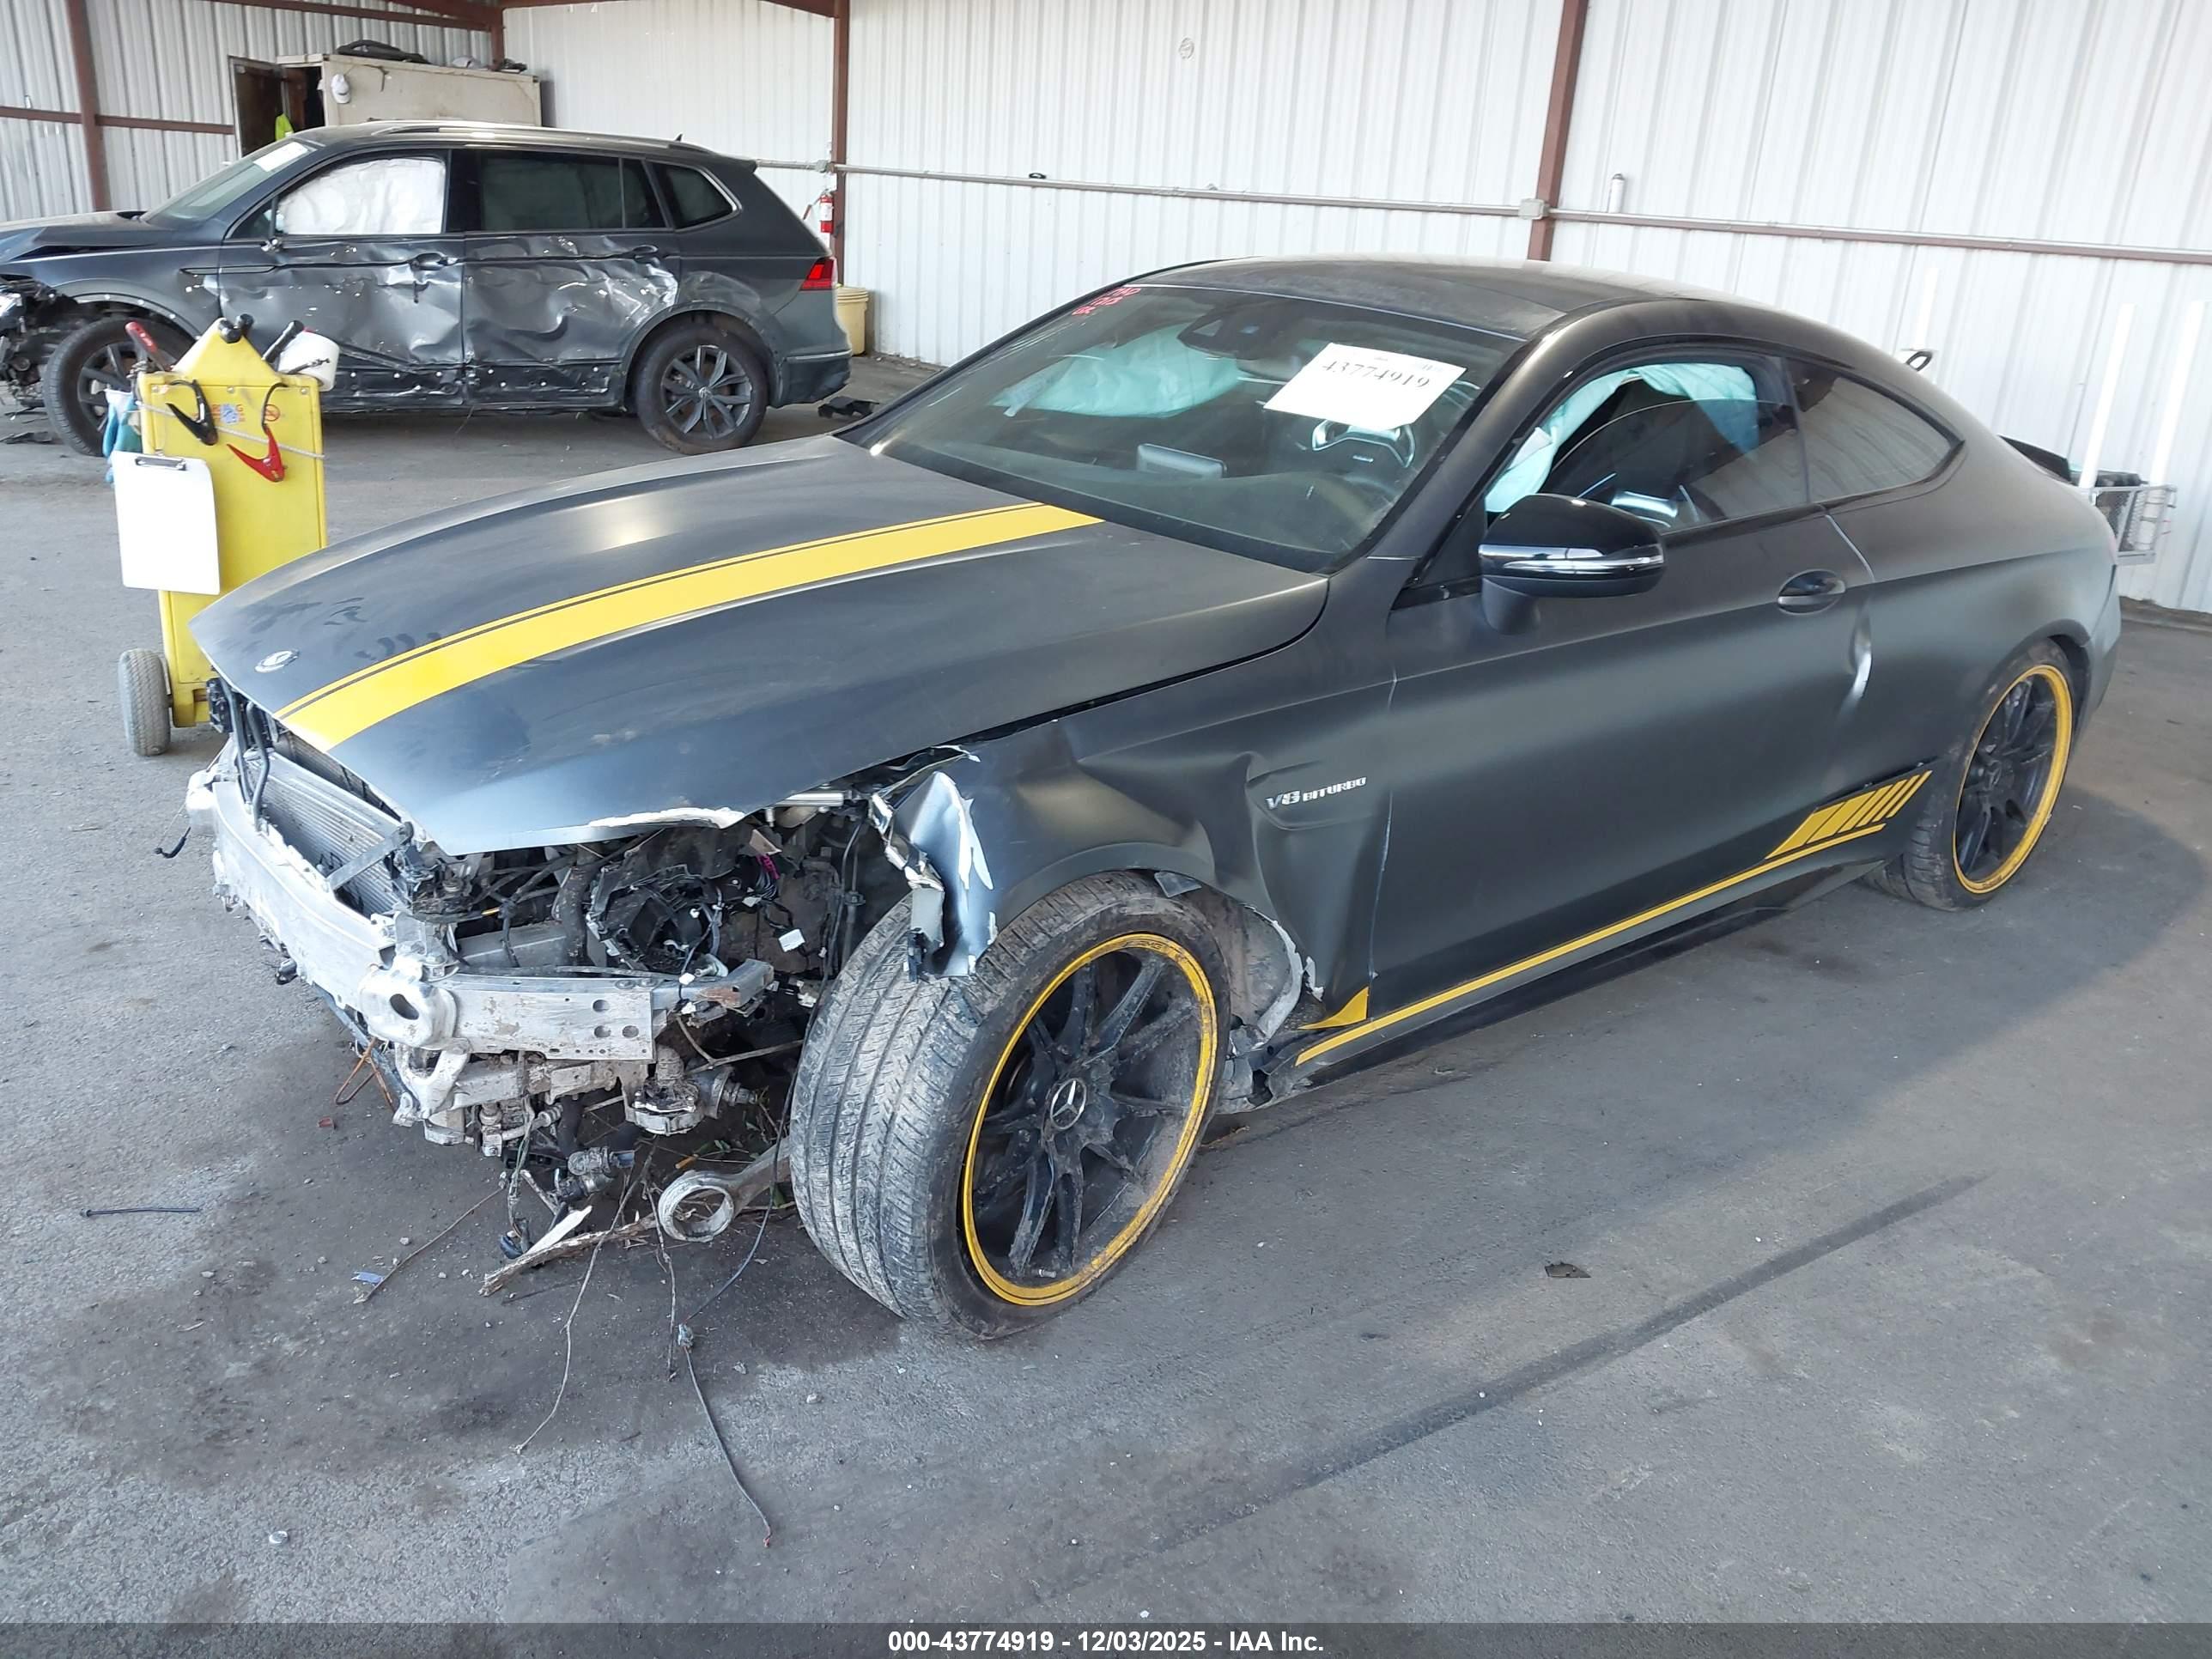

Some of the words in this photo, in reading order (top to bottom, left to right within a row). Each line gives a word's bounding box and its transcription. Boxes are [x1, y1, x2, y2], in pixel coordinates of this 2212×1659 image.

[1322, 360, 1430, 388] 43774919
[1266, 789, 1300, 809] V8
[1302, 775, 1367, 802] BITURBO
